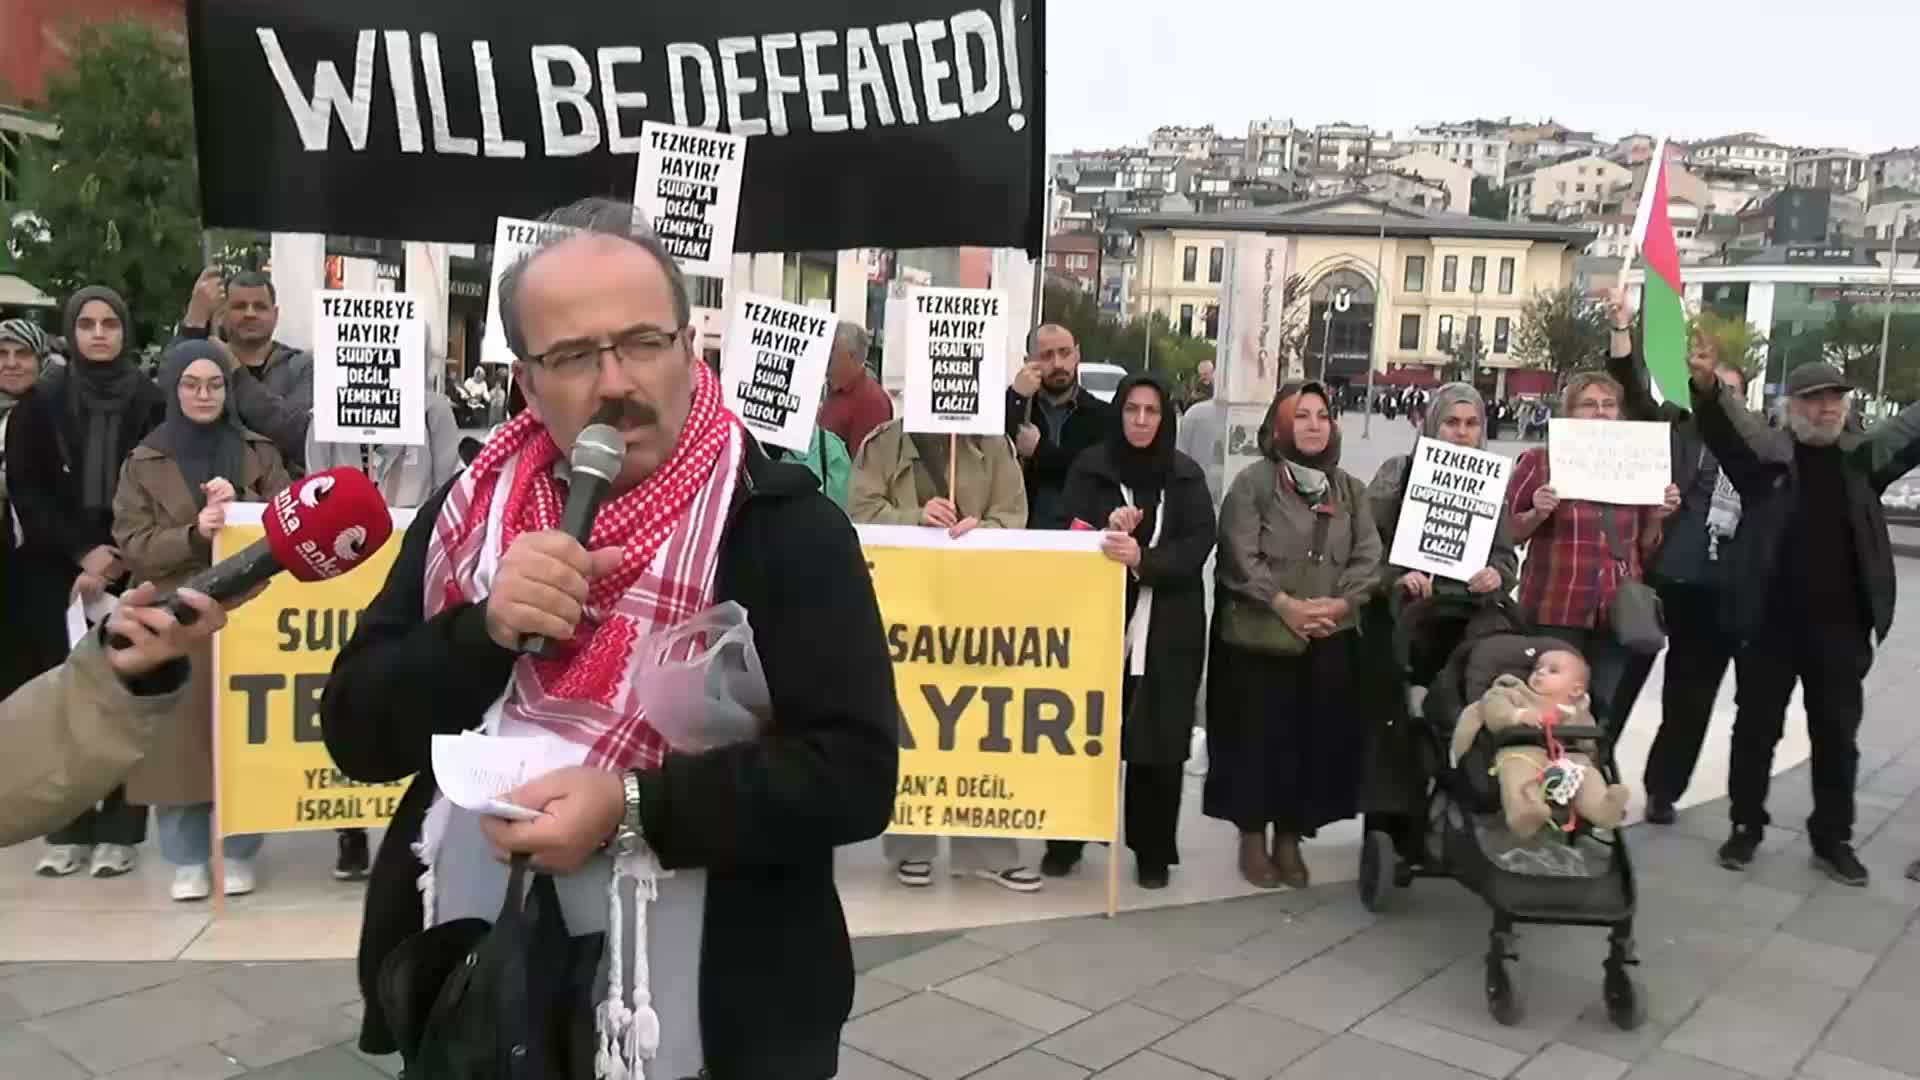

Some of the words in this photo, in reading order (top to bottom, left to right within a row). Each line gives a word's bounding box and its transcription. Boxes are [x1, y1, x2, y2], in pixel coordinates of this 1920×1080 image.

[256, 27, 526, 158] WILL
[531, 45, 648, 157] BE
[666, 0, 1026, 137] DEFEATED!
[651, 131, 736, 160] TEZKEREYE
[661, 156, 720, 182] HAYIR!
[659, 179, 712, 201] SUUD'LA
[666, 199, 704, 220] DEĞİL,
[656, 217, 713, 239] YEMEN'LE
[323, 298, 415, 320] TEZKEREYE
[917, 296, 999, 316] TEZKEREYE
[745, 302, 827, 338] TEZKEREYE
[929, 320, 986, 340] HAYIR!
[338, 323, 400, 344] HAYIR!
[751, 327, 809, 357] HAYIR!
[338, 348, 396, 365] SUUD'LA
[934, 359, 974, 376] ASKERİ
[349, 367, 389, 386] DEĞİL,
[933, 378, 978, 393] OLMAYA
[338, 387, 400, 405] YEMEN'LE
[341, 406, 397, 425] İTTİFAK!
[1425, 446, 1502, 479] TEZKEREYE
[1431, 469, 1486, 497] HAYIR!
[888, 623, 1070, 669] SAVUNAN
[957, 774, 1015, 800] DEĞİL,
[942, 807, 1046, 830] AMBARGO!
